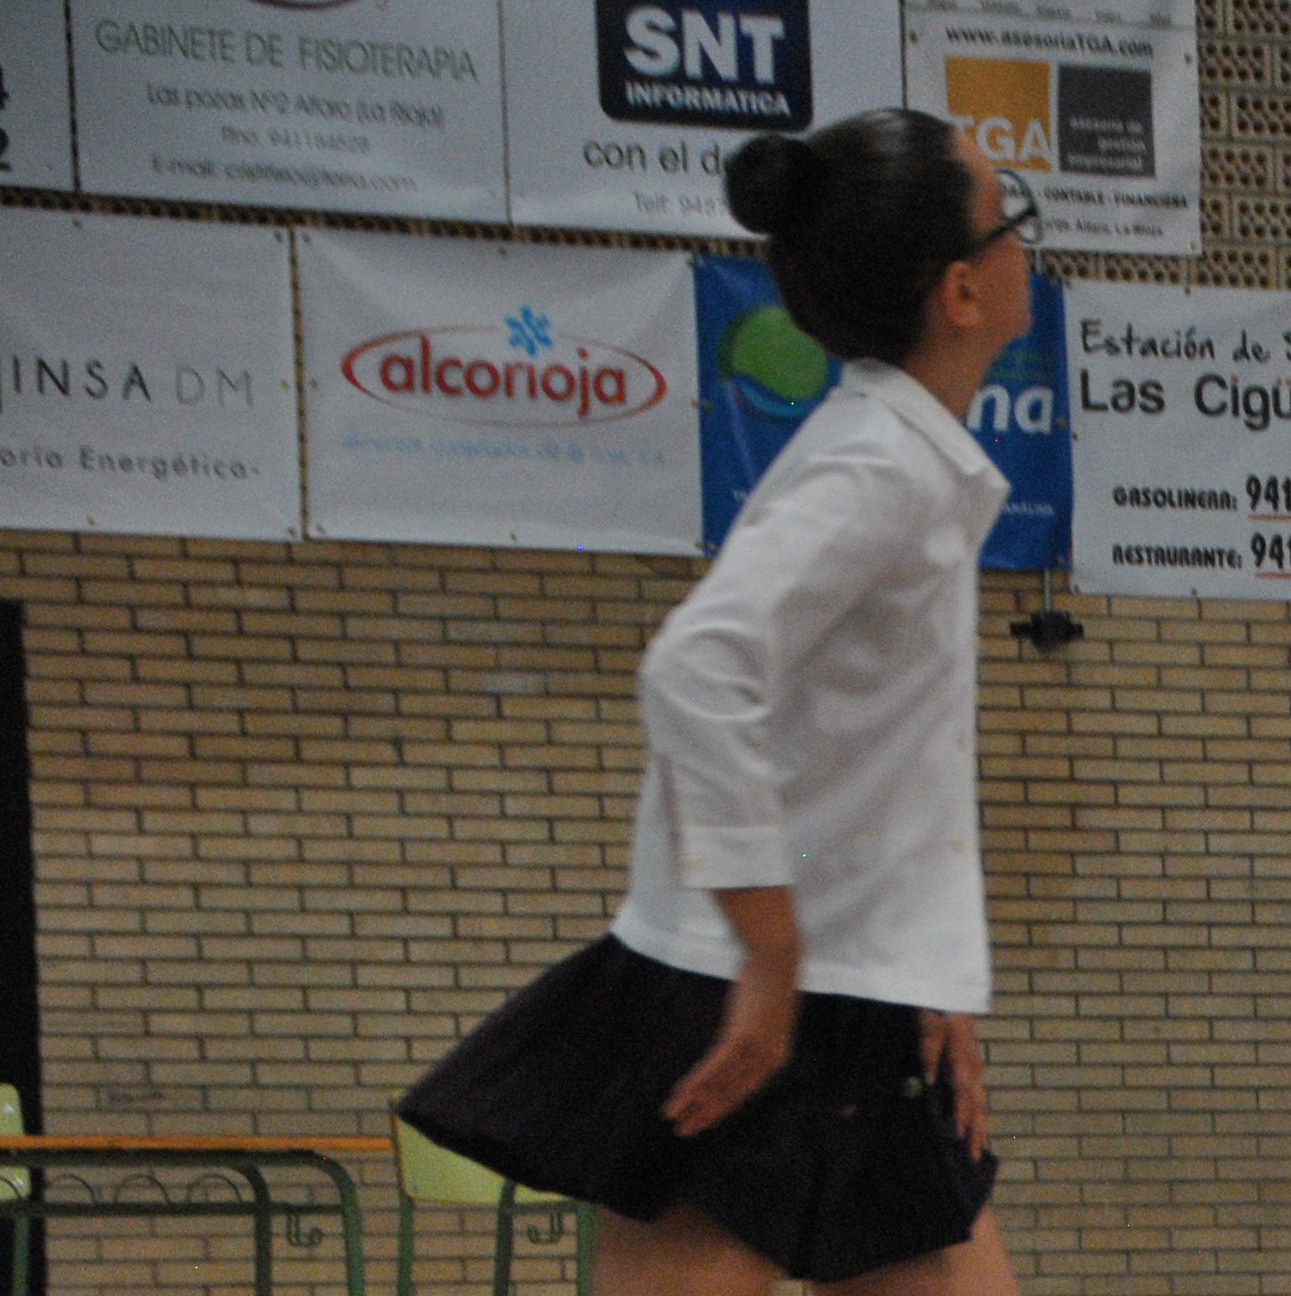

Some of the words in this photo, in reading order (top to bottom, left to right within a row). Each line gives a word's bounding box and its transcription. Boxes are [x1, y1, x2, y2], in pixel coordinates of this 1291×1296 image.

[95, 19, 235, 63] GABINETE
[245, 32, 283, 67] DE
[298, 36, 479, 83] FISIOTERAPIA
[624, 5, 785, 84] SNT
[583, 140, 647, 172] con
[659, 140, 689, 173] el
[1080, 317, 1215, 362] Estación
[1232, 328, 1271, 364] de
[176, 364, 254, 408] DM
[380, 332, 627, 419] alcorioja
[1080, 368, 1166, 414] Las
[966, 383, 1055, 436] na
[1112, 485, 1238, 512] GASOLINERA:
[1112, 543, 1243, 571] RESTAURANTE:
